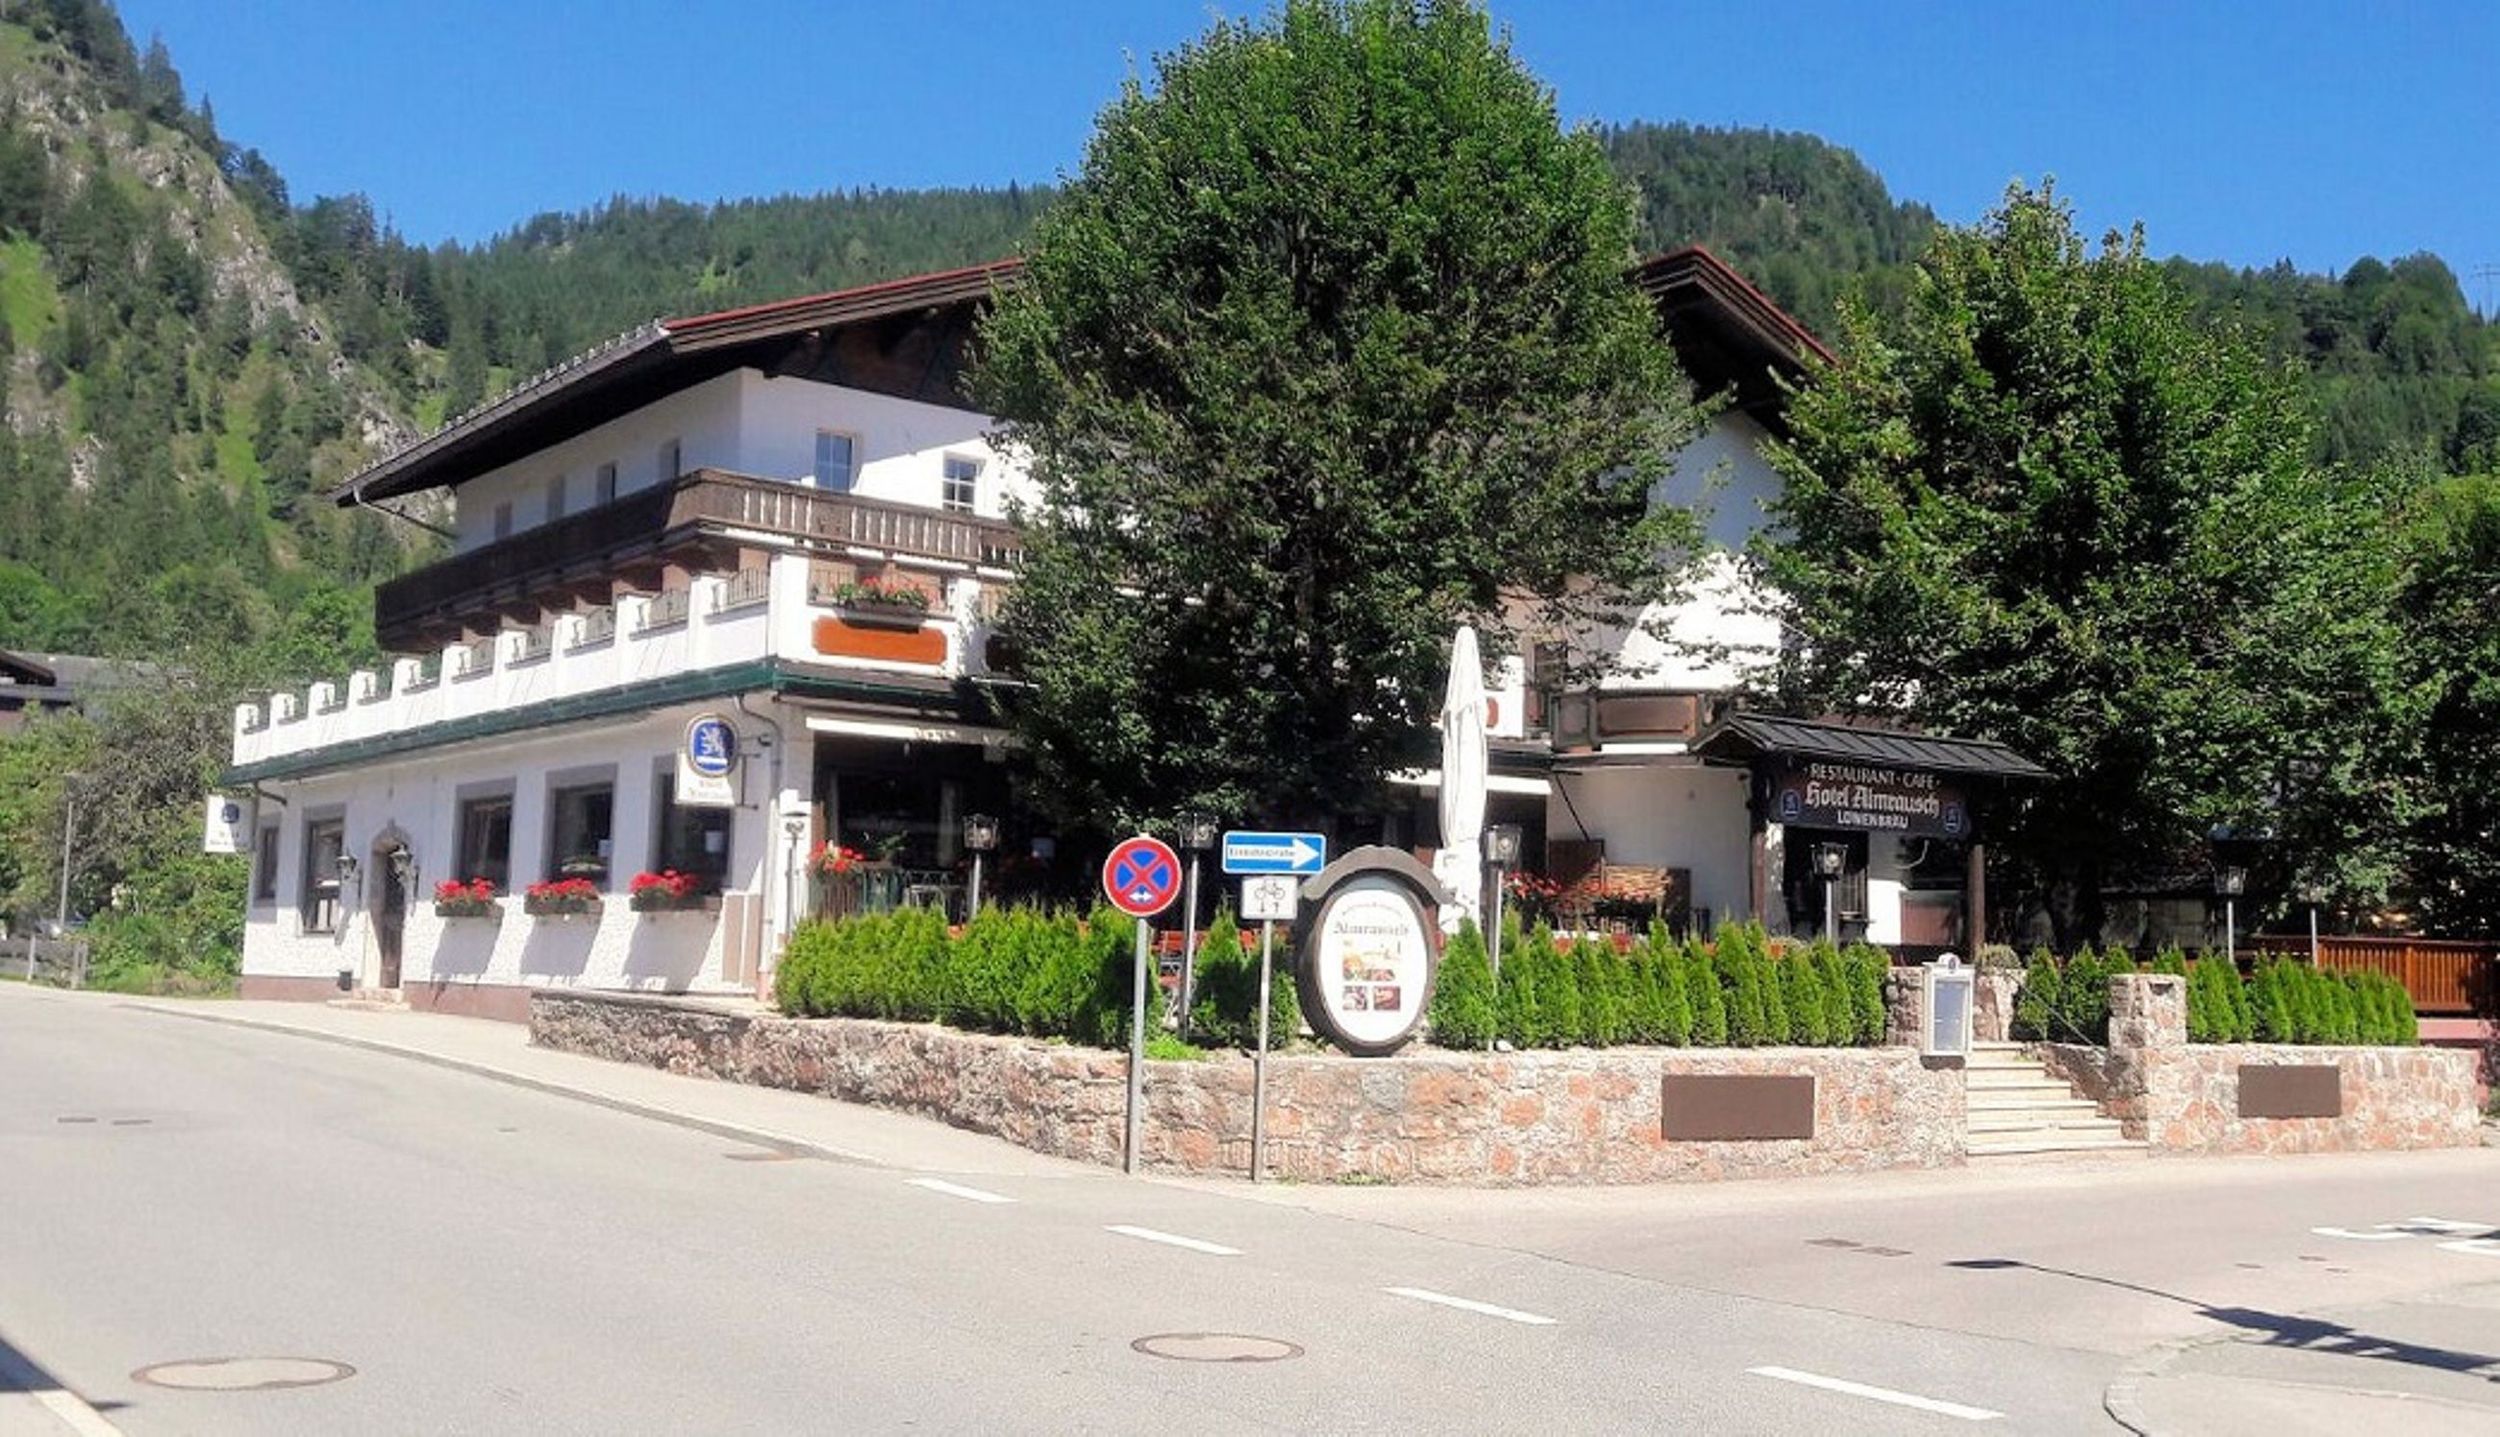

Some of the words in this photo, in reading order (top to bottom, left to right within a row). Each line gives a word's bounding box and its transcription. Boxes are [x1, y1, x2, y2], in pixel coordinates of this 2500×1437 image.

[1809, 763, 1895, 785] RESTAURANT
[1805, 780, 1850, 809] Hotel
[1851, 784, 1941, 819] Almrausch
